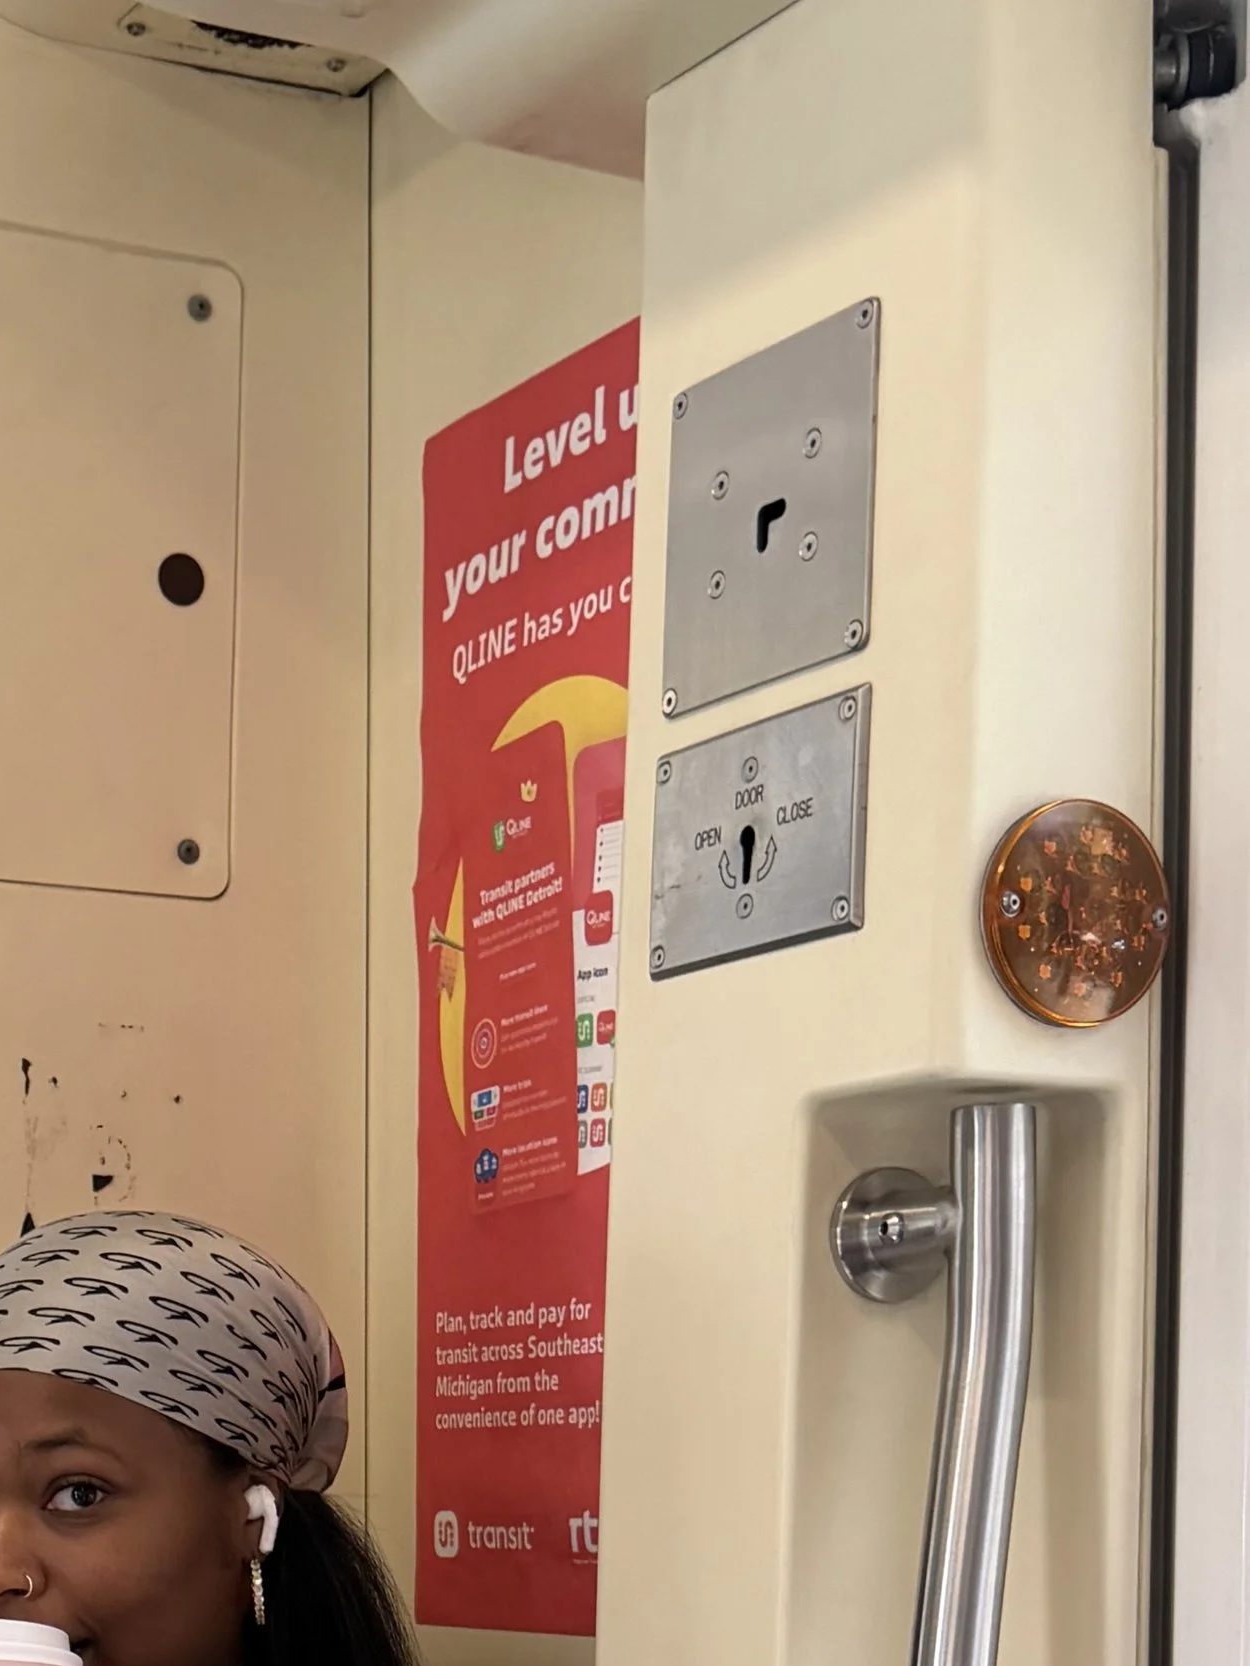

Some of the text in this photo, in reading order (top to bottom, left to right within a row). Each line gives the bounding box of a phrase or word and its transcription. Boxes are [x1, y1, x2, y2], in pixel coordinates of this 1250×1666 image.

[503, 385, 606, 493] Level
[442, 529, 527, 622] your
[452, 617, 517, 685] QLINE
[522, 605, 563, 649] has
[567, 582, 612, 638] you
[734, 784, 765, 810] DOOR
[776, 798, 814, 826] CLOSE
[694, 826, 723, 851] OPEN
[480, 862, 555, 905] Transit partners
[472, 908, 495, 929] with
[496, 894, 525, 920] QLINE
[577, 967, 592, 981] App
[436, 1298, 592, 1335] Plan, track and pay for
[436, 1331, 603, 1366] transit across Southeast
[435, 1369, 559, 1400] Michigan from the
[435, 1401, 600, 1430] convenience of one app!
[467, 1520, 533, 1550] transit
